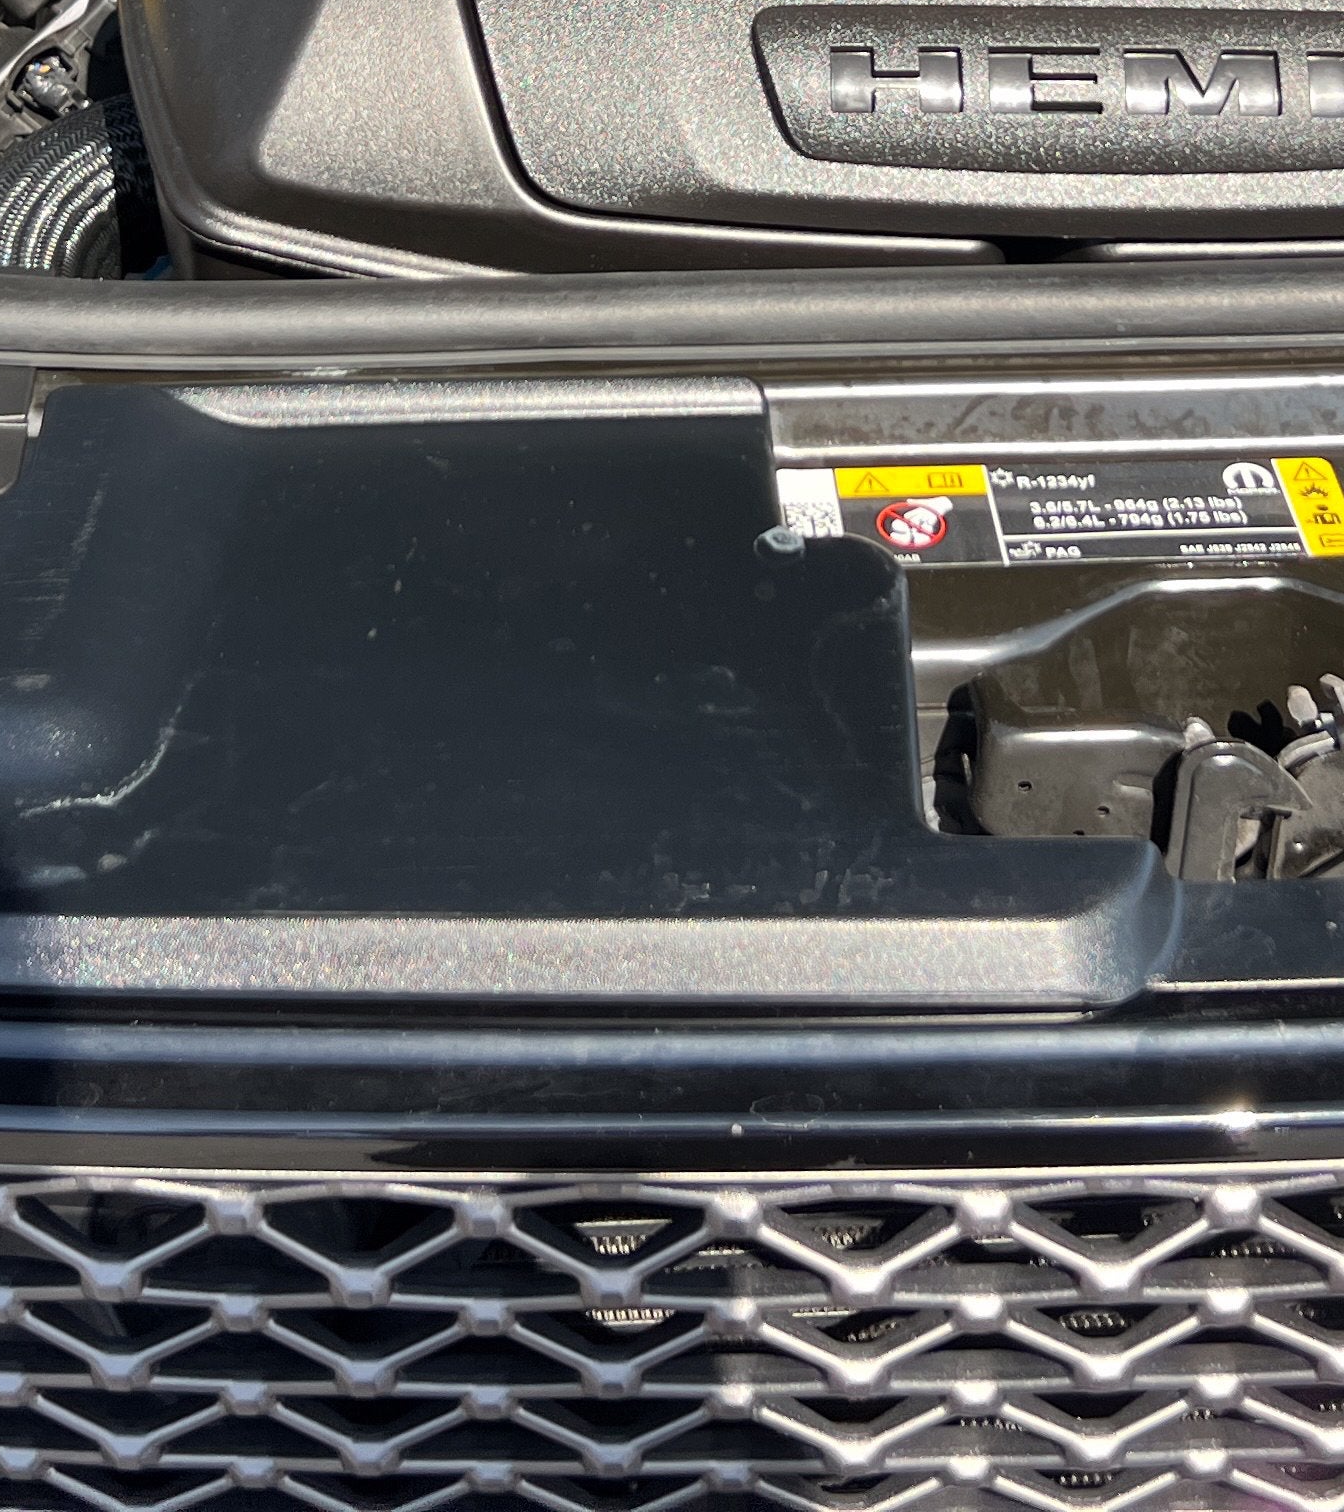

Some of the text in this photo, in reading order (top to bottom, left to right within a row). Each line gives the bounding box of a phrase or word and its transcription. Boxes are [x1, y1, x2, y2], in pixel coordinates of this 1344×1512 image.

[1016, 473, 1095, 491] R-1234yf
[1030, 499, 1101, 515] 3.6/5.7L
[1207, 495, 1243, 510] lbs)
[1033, 514, 1106, 530] 6.2/6.4L
[1167, 510, 1211, 527] (1.75
[1212, 509, 1248, 526] lbs)
[1045, 545, 1081, 559] PAG
